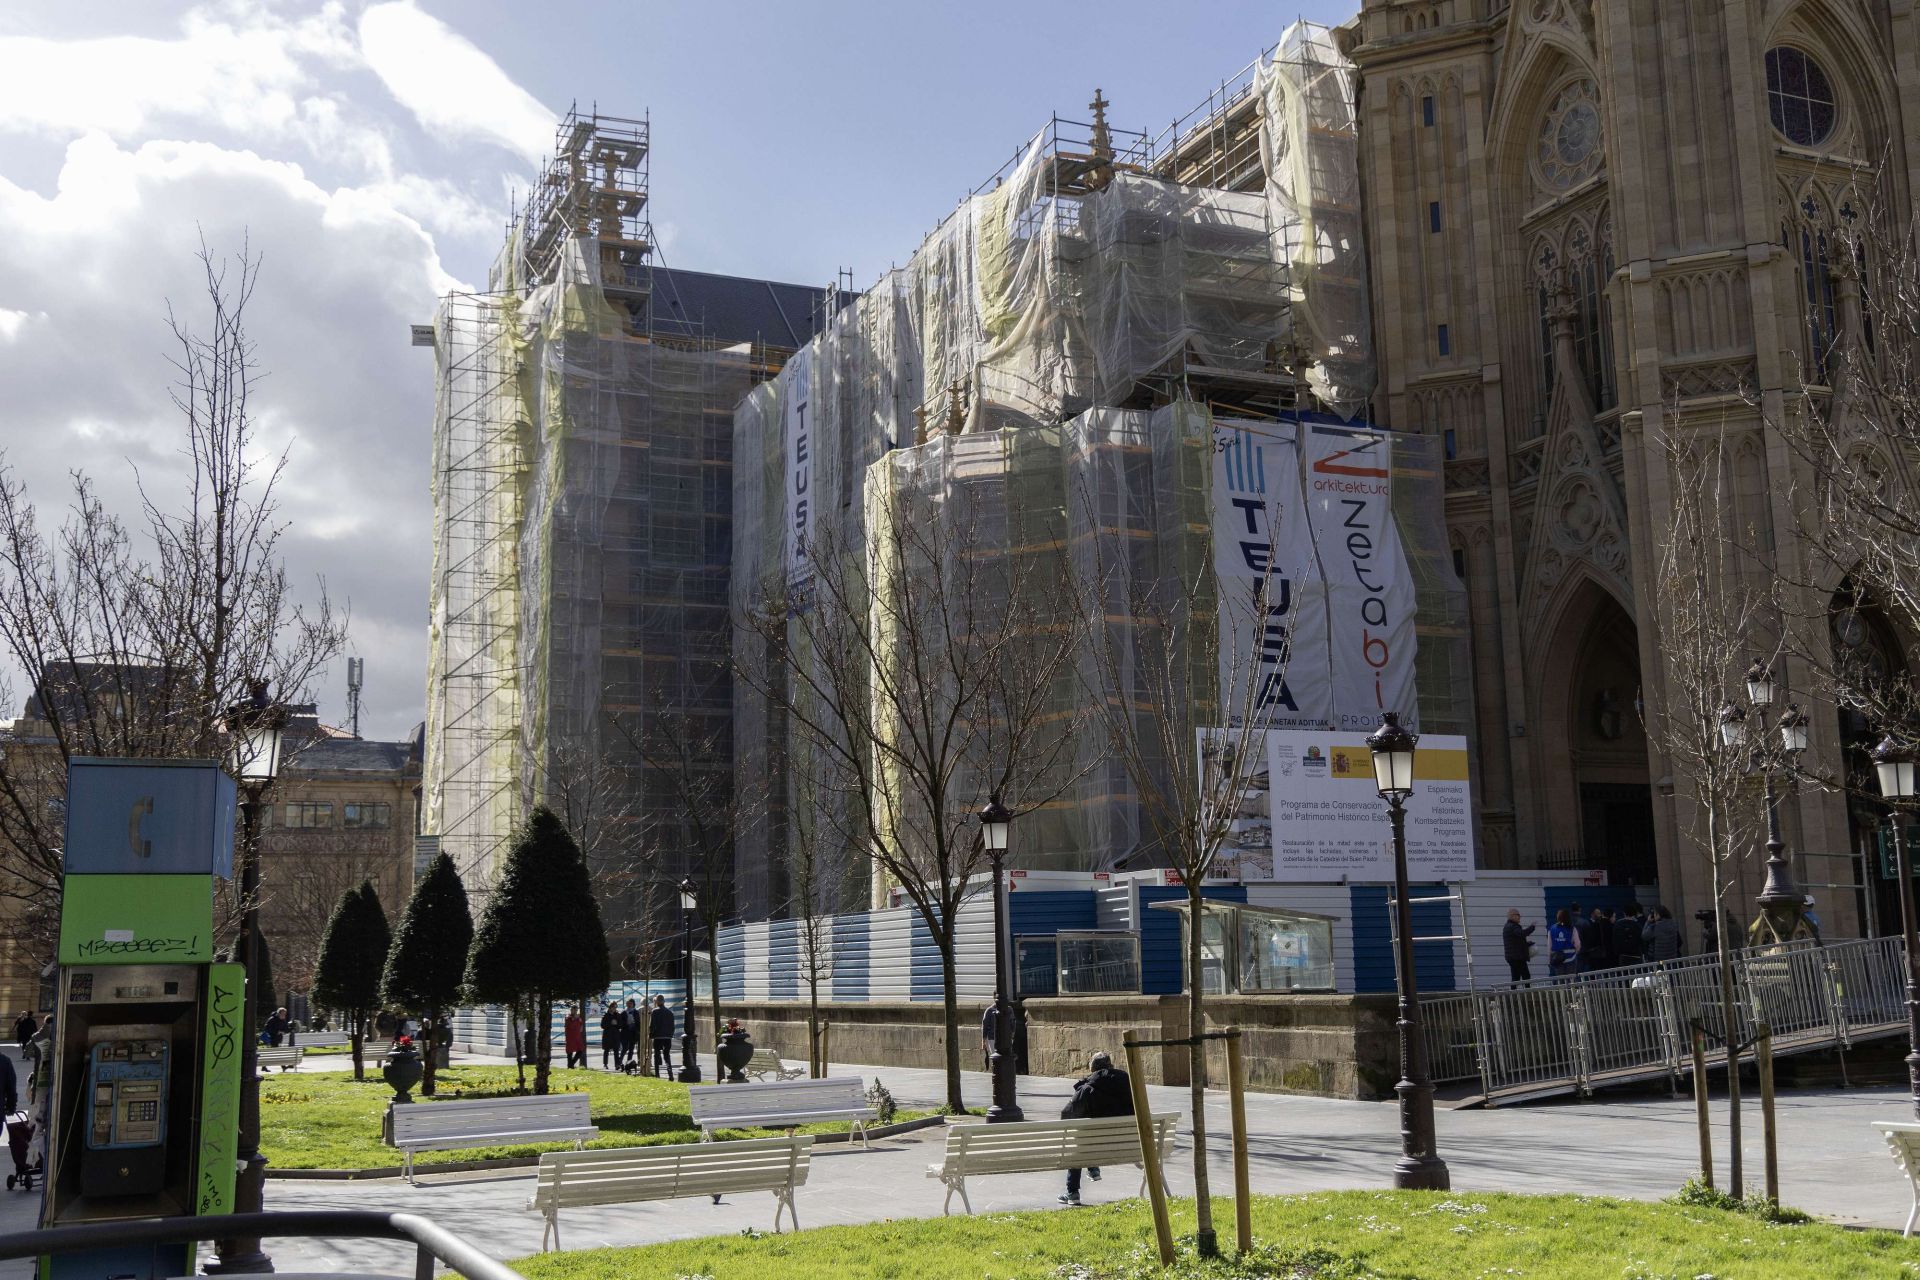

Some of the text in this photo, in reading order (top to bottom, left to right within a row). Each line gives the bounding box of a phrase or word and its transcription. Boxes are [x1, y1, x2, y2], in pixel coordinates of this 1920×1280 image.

[796, 401, 808, 559] TEUSA
[1231, 497, 1299, 712] TEUSA
[1341, 715, 1415, 727] PROIEUA
[1280, 800, 1318, 811] Programa
[1320, 801, 1330, 809] de
[1431, 806, 1464, 815] Historikoa
[1281, 812, 1293, 821] del
[1295, 812, 1336, 821] Patrimonio
[1414, 817, 1465, 825] Kontserbatzeko
[1433, 827, 1466, 837] Programa
